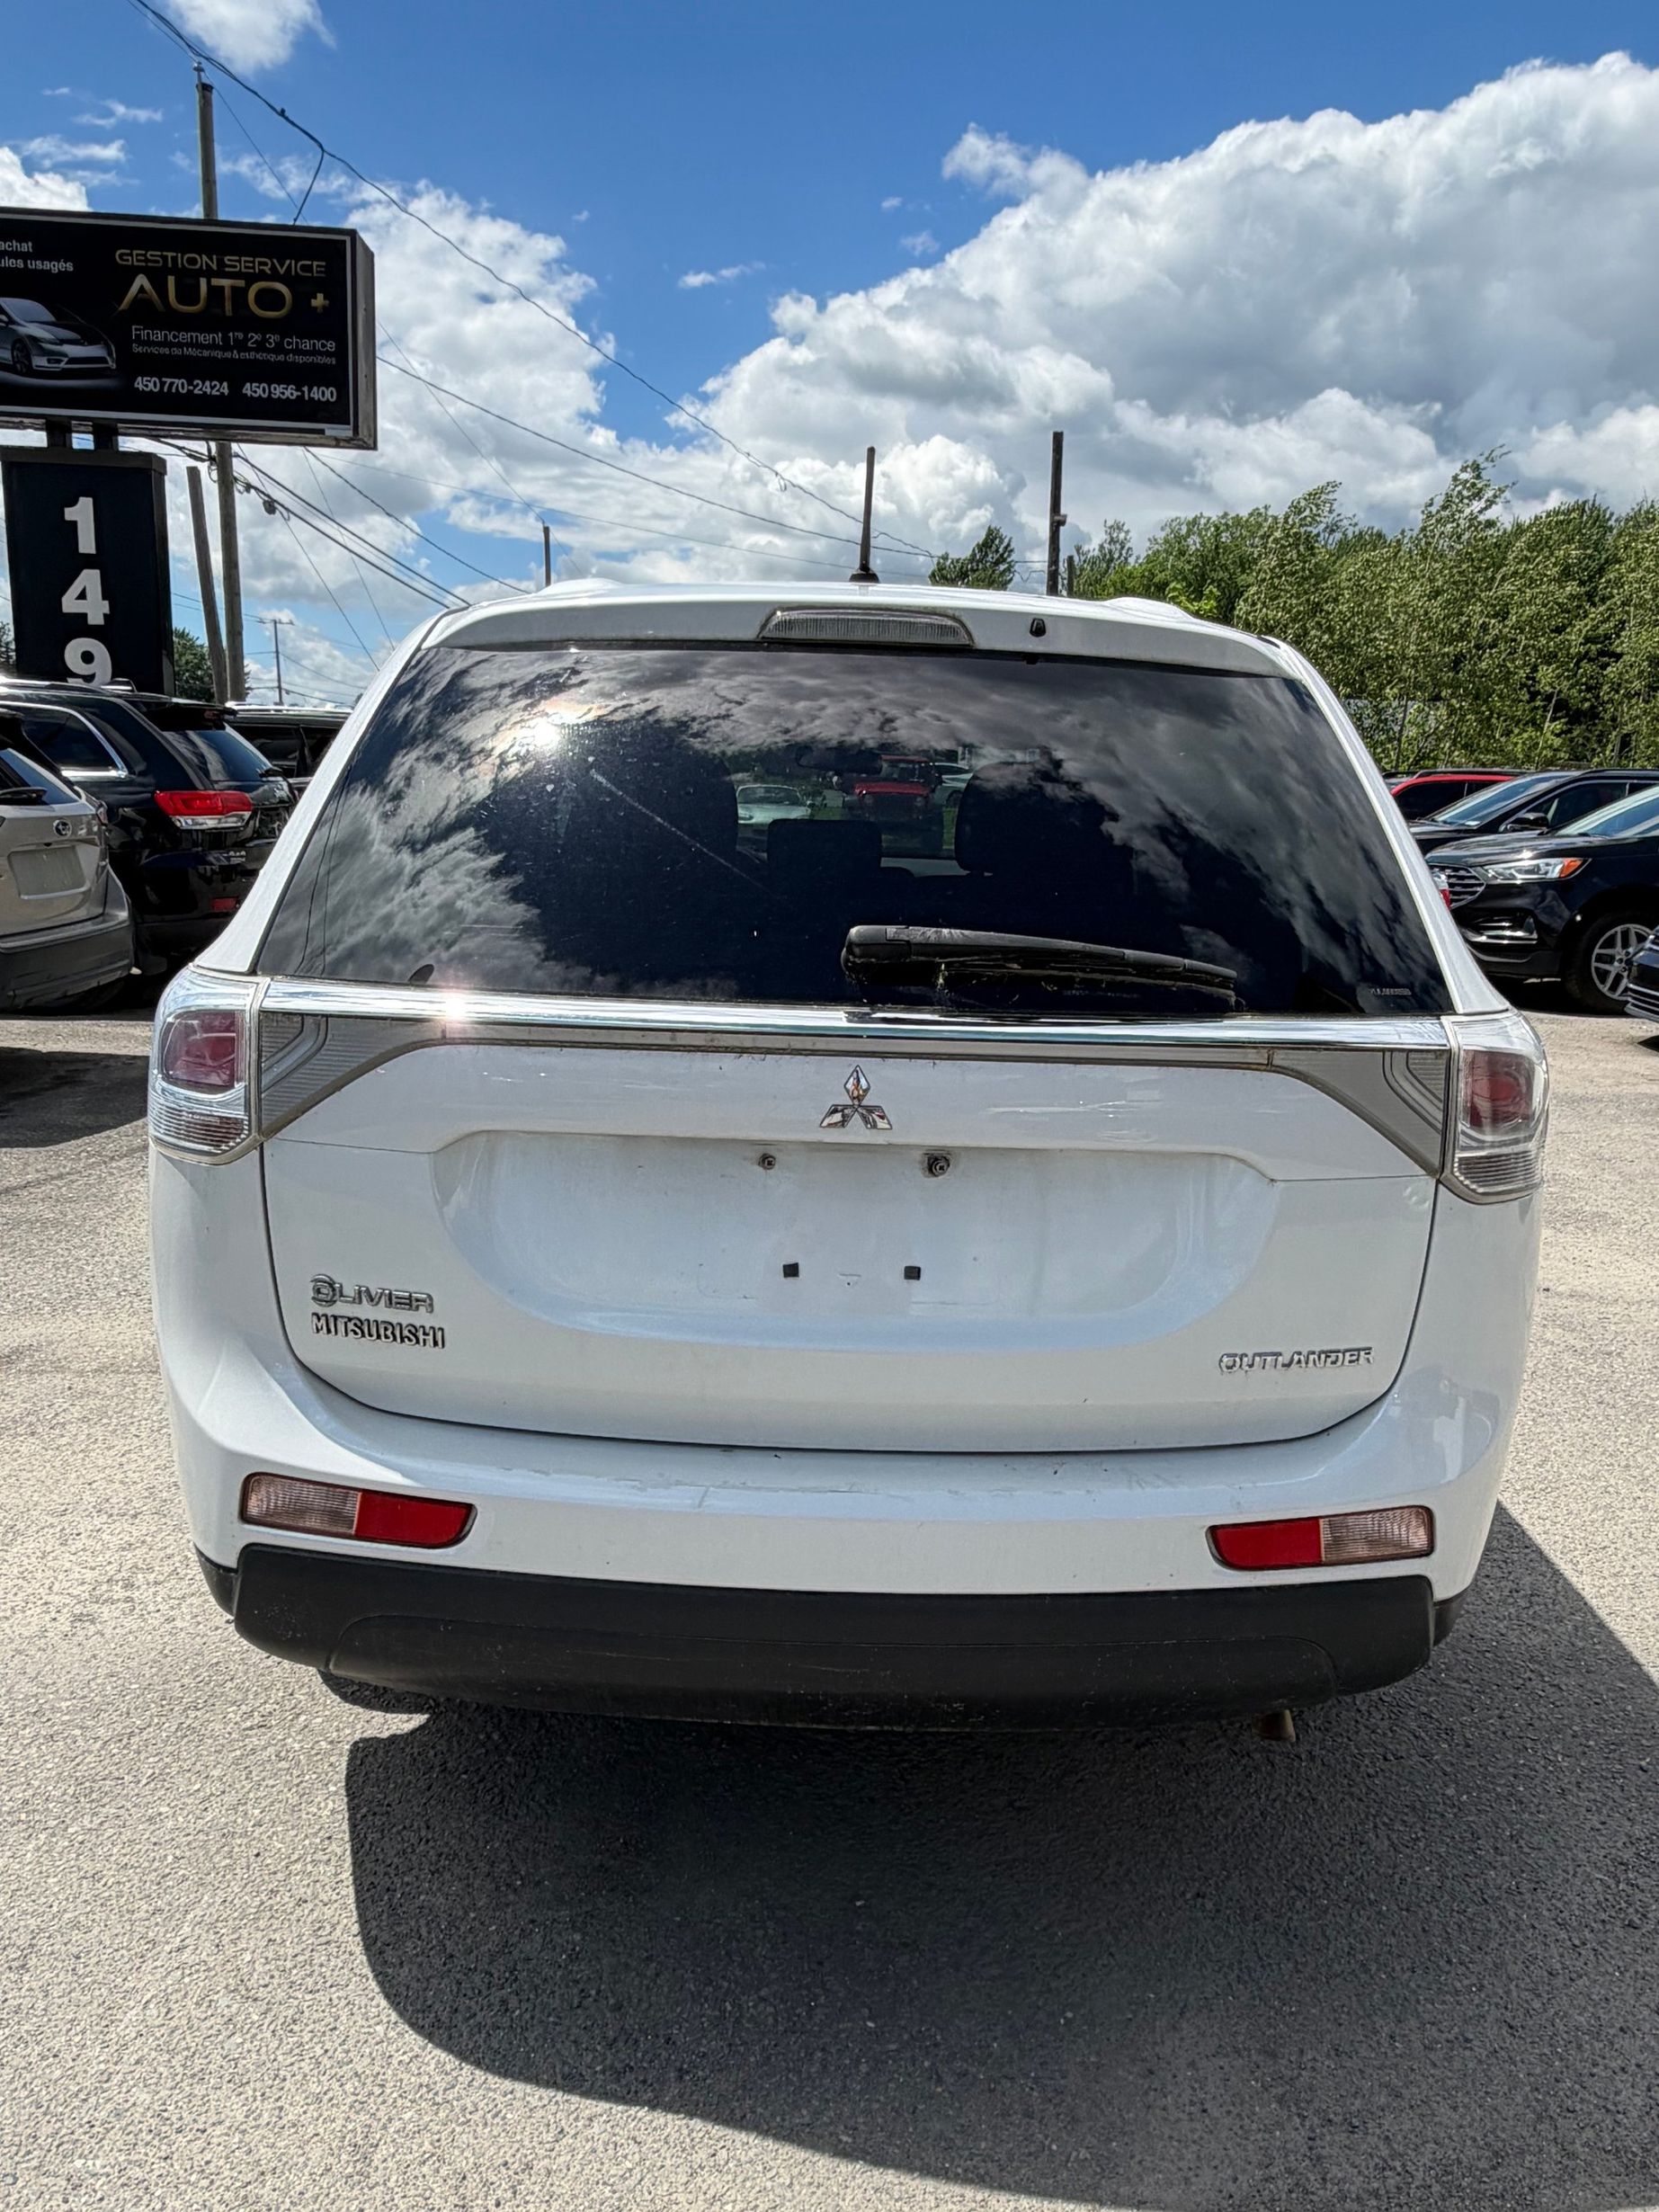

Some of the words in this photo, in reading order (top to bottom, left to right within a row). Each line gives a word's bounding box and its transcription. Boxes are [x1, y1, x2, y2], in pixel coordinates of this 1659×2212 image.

[28, 259, 74, 273] usagés
[115, 249, 218, 271] GESTION
[224, 255, 326, 277] SERVICE
[118, 273, 292, 318] AUTO
[131, 325, 223, 345] Financement
[283, 334, 335, 352] chance
[134, 376, 160, 392] 450
[162, 378, 229, 397] 770-2424
[242, 382, 269, 397] 450
[270, 383, 337, 402] 956-1400
[311, 1312, 445, 1350] MITSUBISHI
[1218, 1347, 1374, 1373] OUTLANDER
